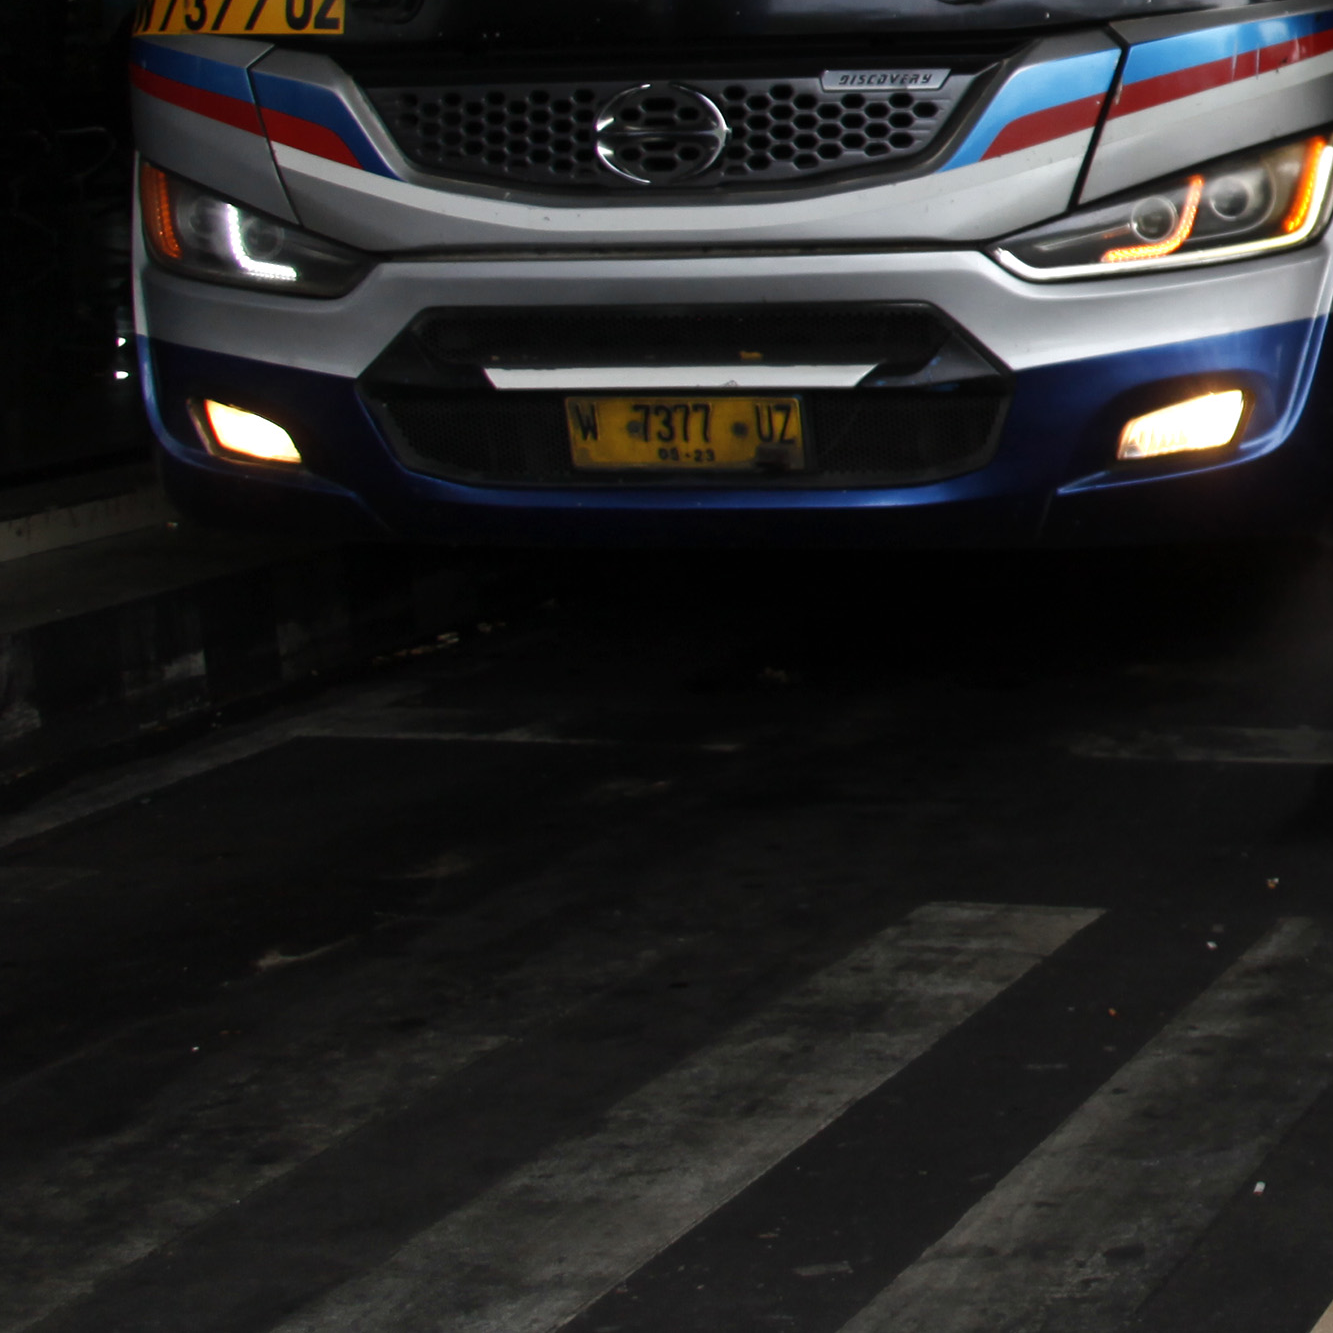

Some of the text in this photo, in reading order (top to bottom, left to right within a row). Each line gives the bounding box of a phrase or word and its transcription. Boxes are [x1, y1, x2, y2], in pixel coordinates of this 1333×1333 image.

[838, 73, 933, 86] DISCOVERY
[574, 402, 795, 444] W 7377 UZ
